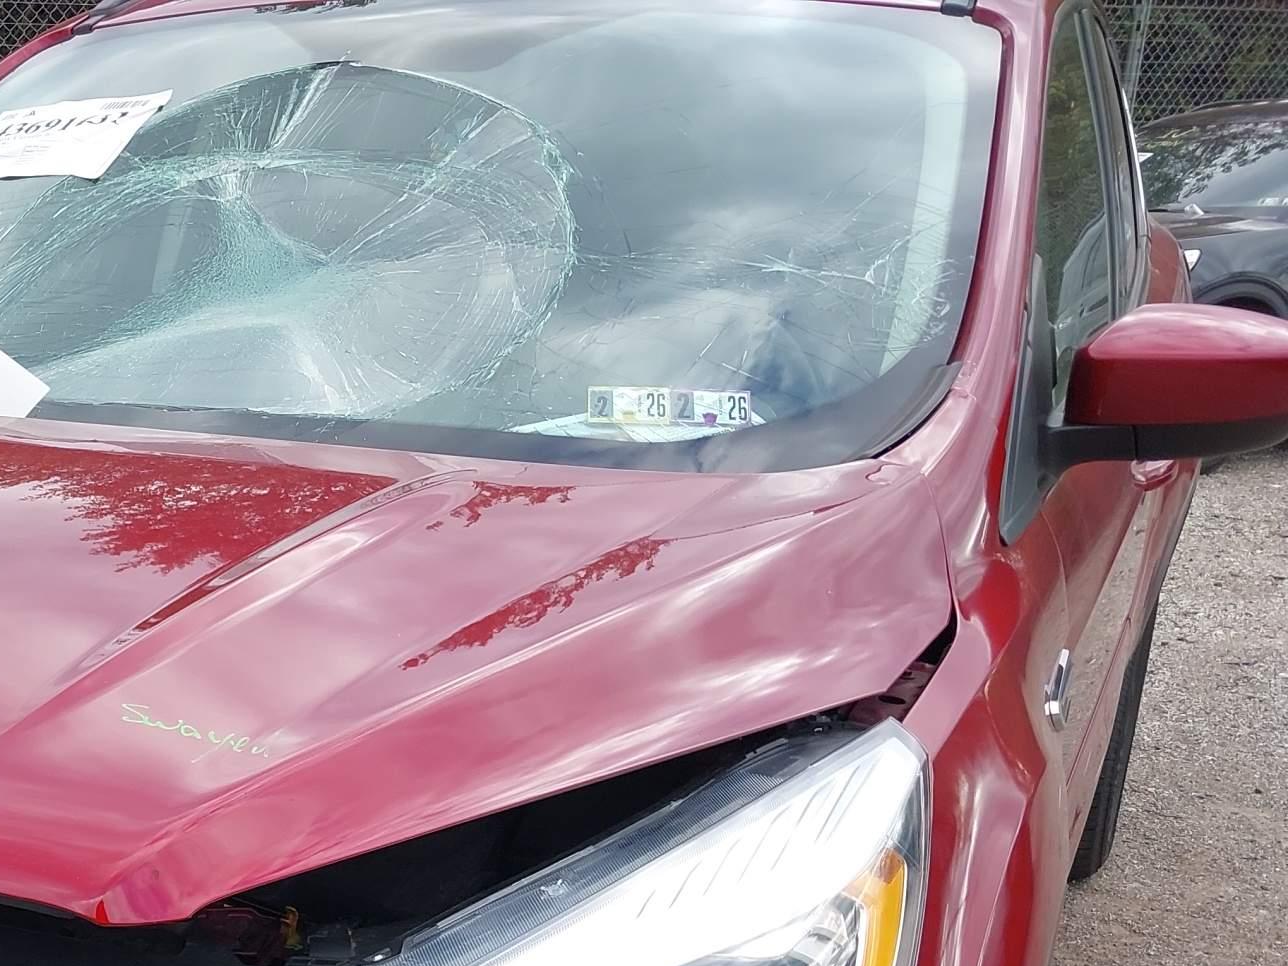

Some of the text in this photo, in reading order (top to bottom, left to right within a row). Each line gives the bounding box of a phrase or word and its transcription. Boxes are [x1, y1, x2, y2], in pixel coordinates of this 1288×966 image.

[596, 392, 666, 418] 2 26
[677, 392, 748, 421] 2 26
